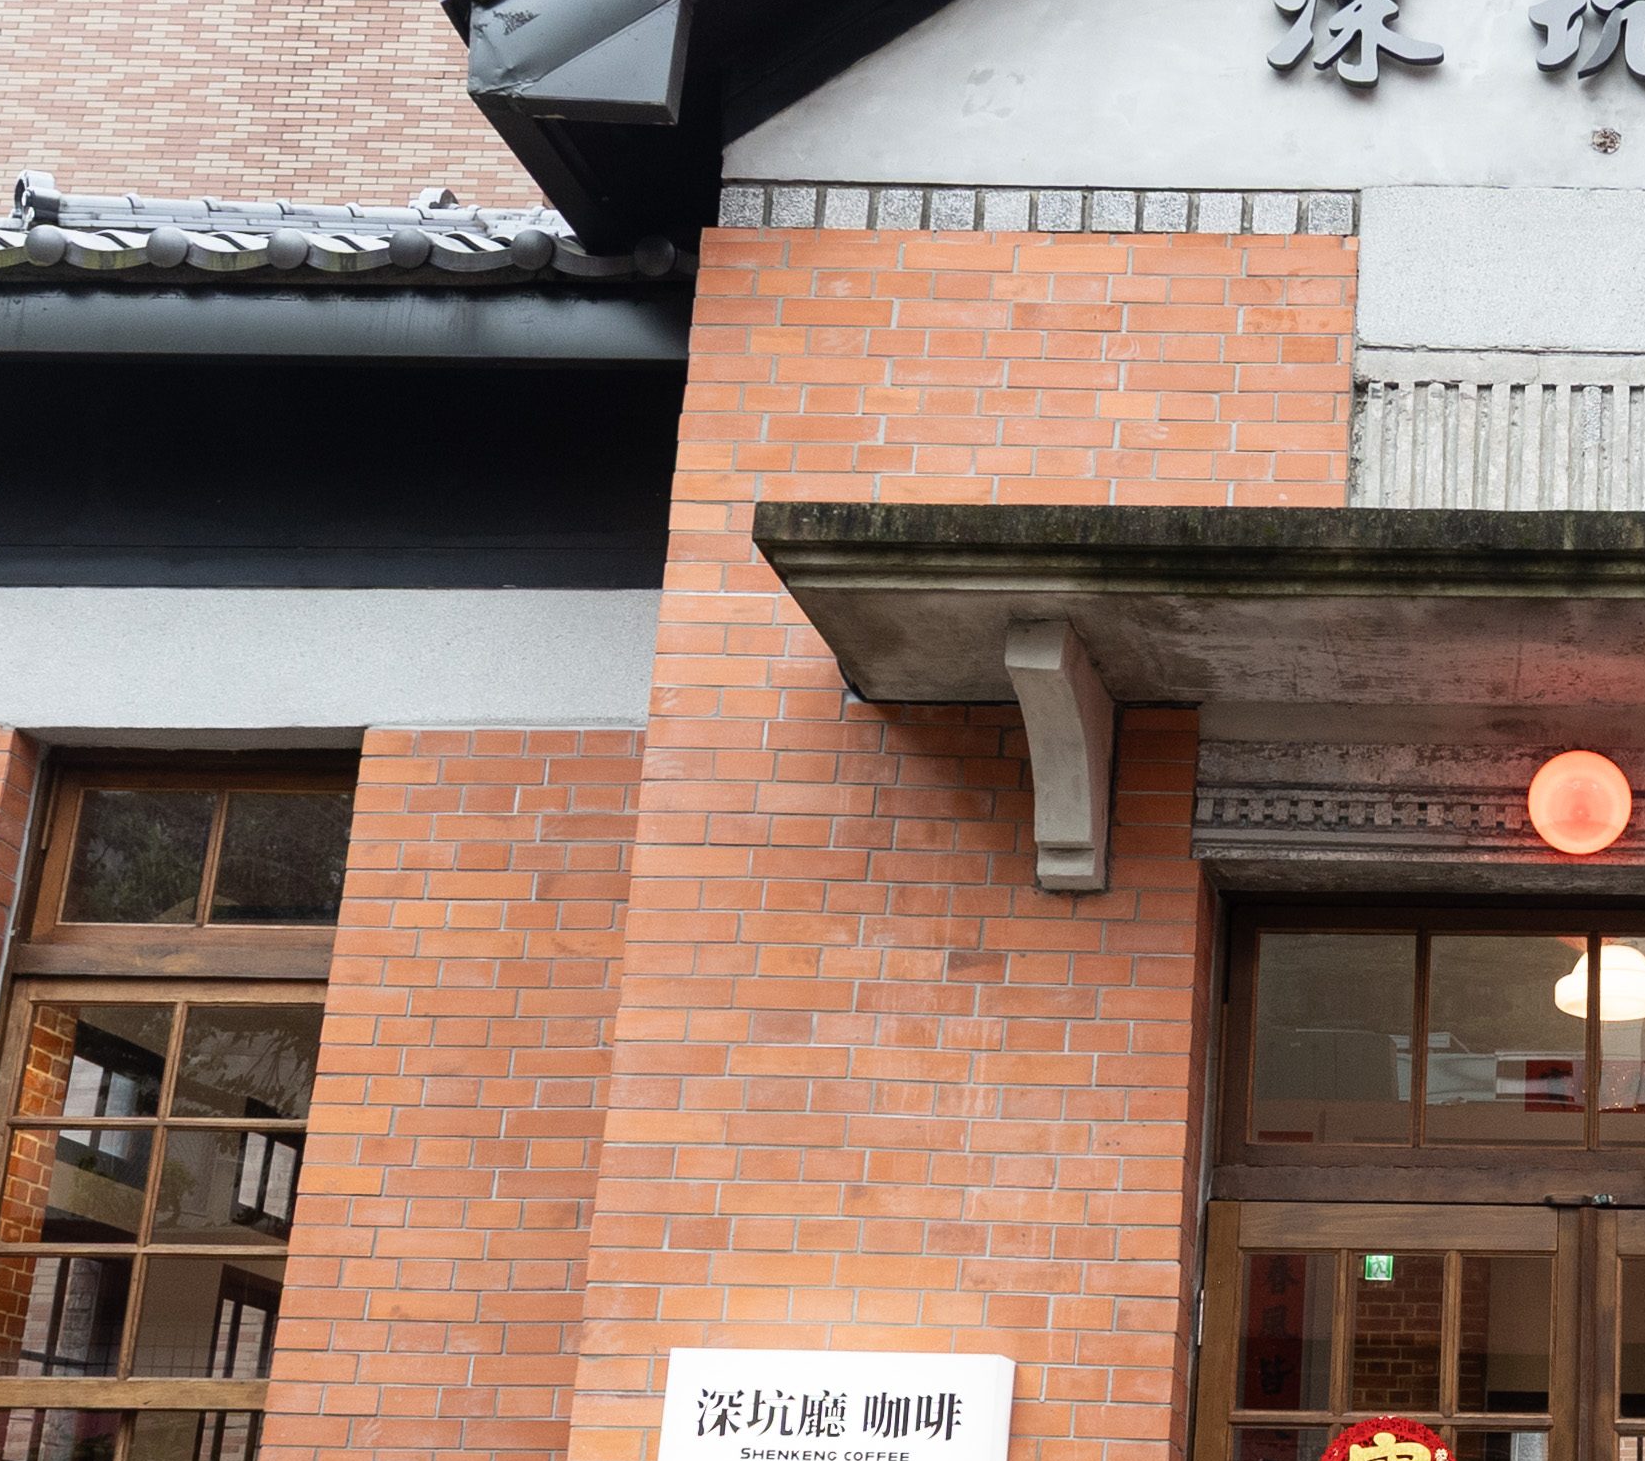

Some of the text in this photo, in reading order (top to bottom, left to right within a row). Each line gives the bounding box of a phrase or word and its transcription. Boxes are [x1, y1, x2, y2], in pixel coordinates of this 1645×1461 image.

[697, 1388, 963, 1441] 深坑廳 咖啡
[740, 1447, 838, 1461] SHENKENG
